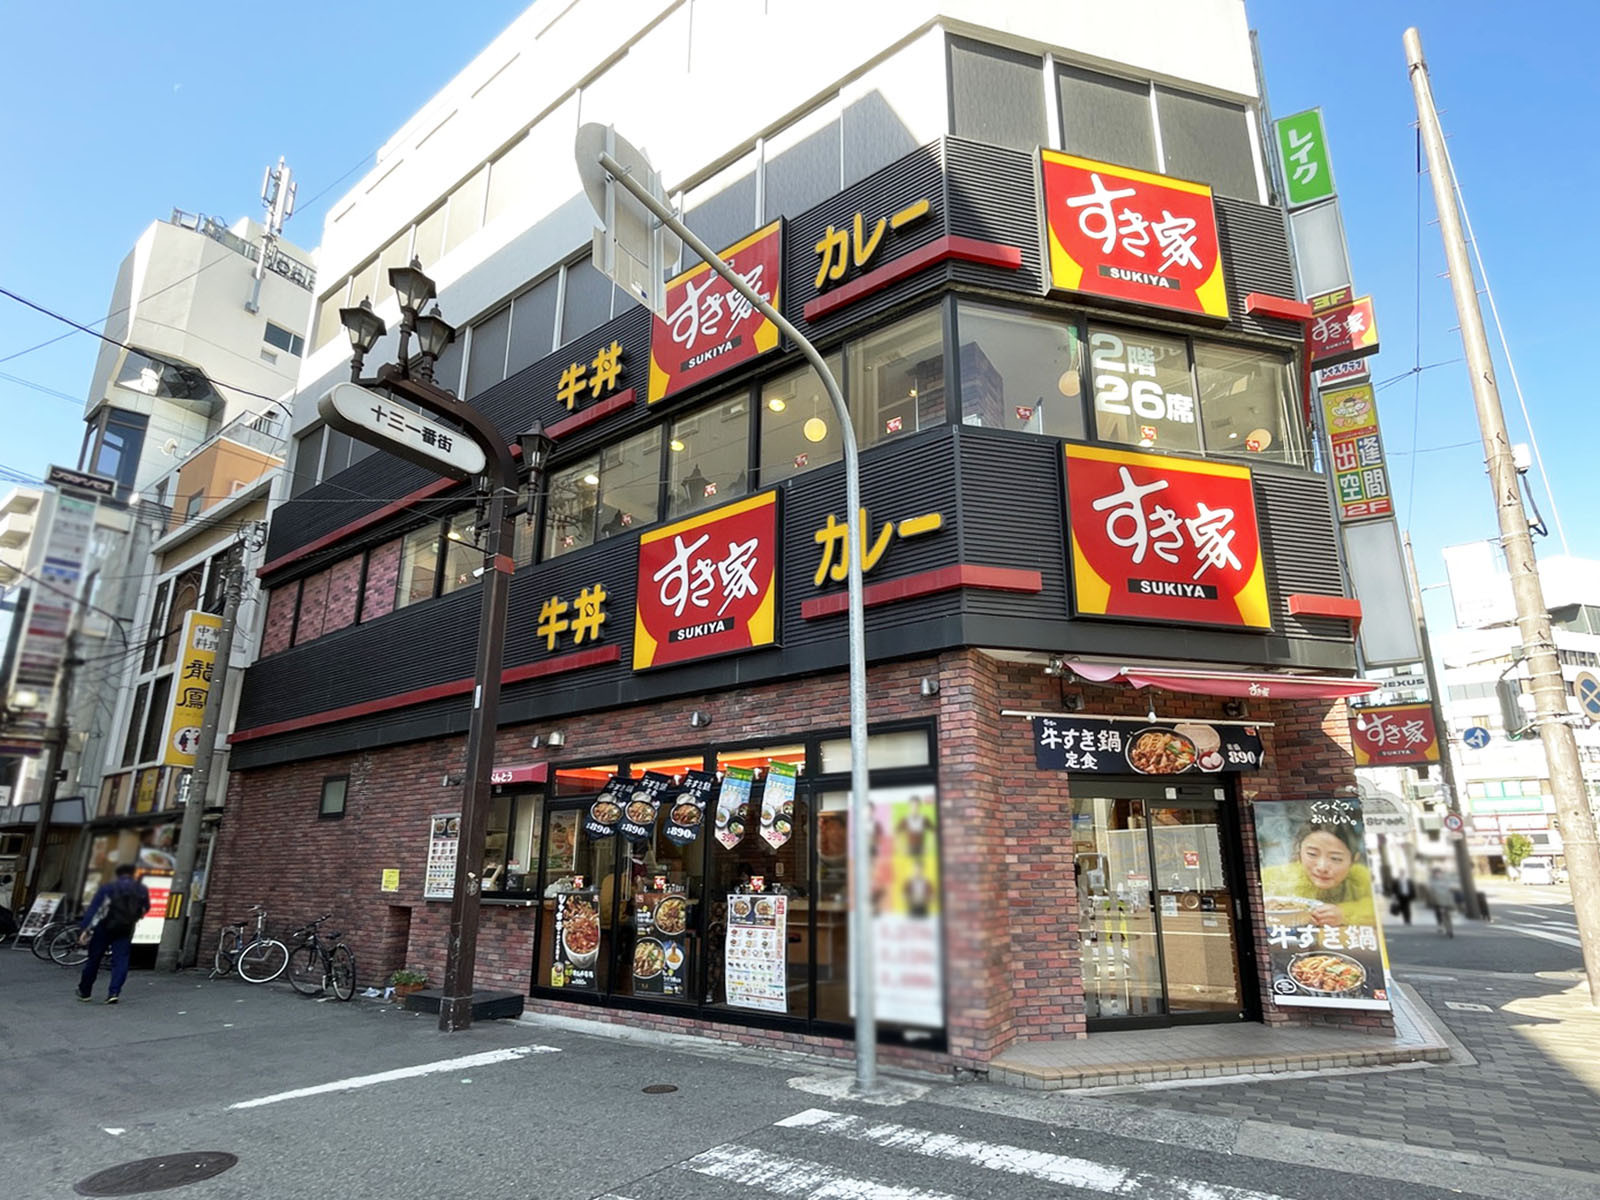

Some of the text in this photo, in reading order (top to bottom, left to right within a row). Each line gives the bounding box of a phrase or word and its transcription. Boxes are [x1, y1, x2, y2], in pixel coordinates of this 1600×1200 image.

[1288, 128, 1318, 184] レイク
[1067, 173, 1203, 273] すき家
[814, 199, 930, 289] カレー
[1110, 266, 1170, 289] SUKIYA
[666, 264, 764, 349] すき家
[1312, 312, 1366, 343] すき家
[688, 341, 733, 368] SUKIYA
[1091, 333, 1156, 377] 2階
[556, 340, 623, 410] 牛丼
[1094, 374, 1194, 423] 26席
[371, 405, 453, 453] 十三一番街
[1092, 466, 1242, 580] すき家
[1347, 500, 1388, 516] 2F
[814, 507, 942, 587] カレー
[653, 535, 759, 617] すき家
[1140, 579, 1206, 599] SUKIYA
[537, 584, 607, 651] 牛丼
[677, 620, 725, 641] SUKIYA
[1041, 726, 1122, 752] 牛すき鍋
[1365, 713, 1428, 749] すき家
[1065, 750, 1098, 770] 定食
[1228, 750, 1257, 764] 890
[1311, 814, 1357, 826] おいしい。
[1267, 923, 1378, 951] 牛すき鍋
